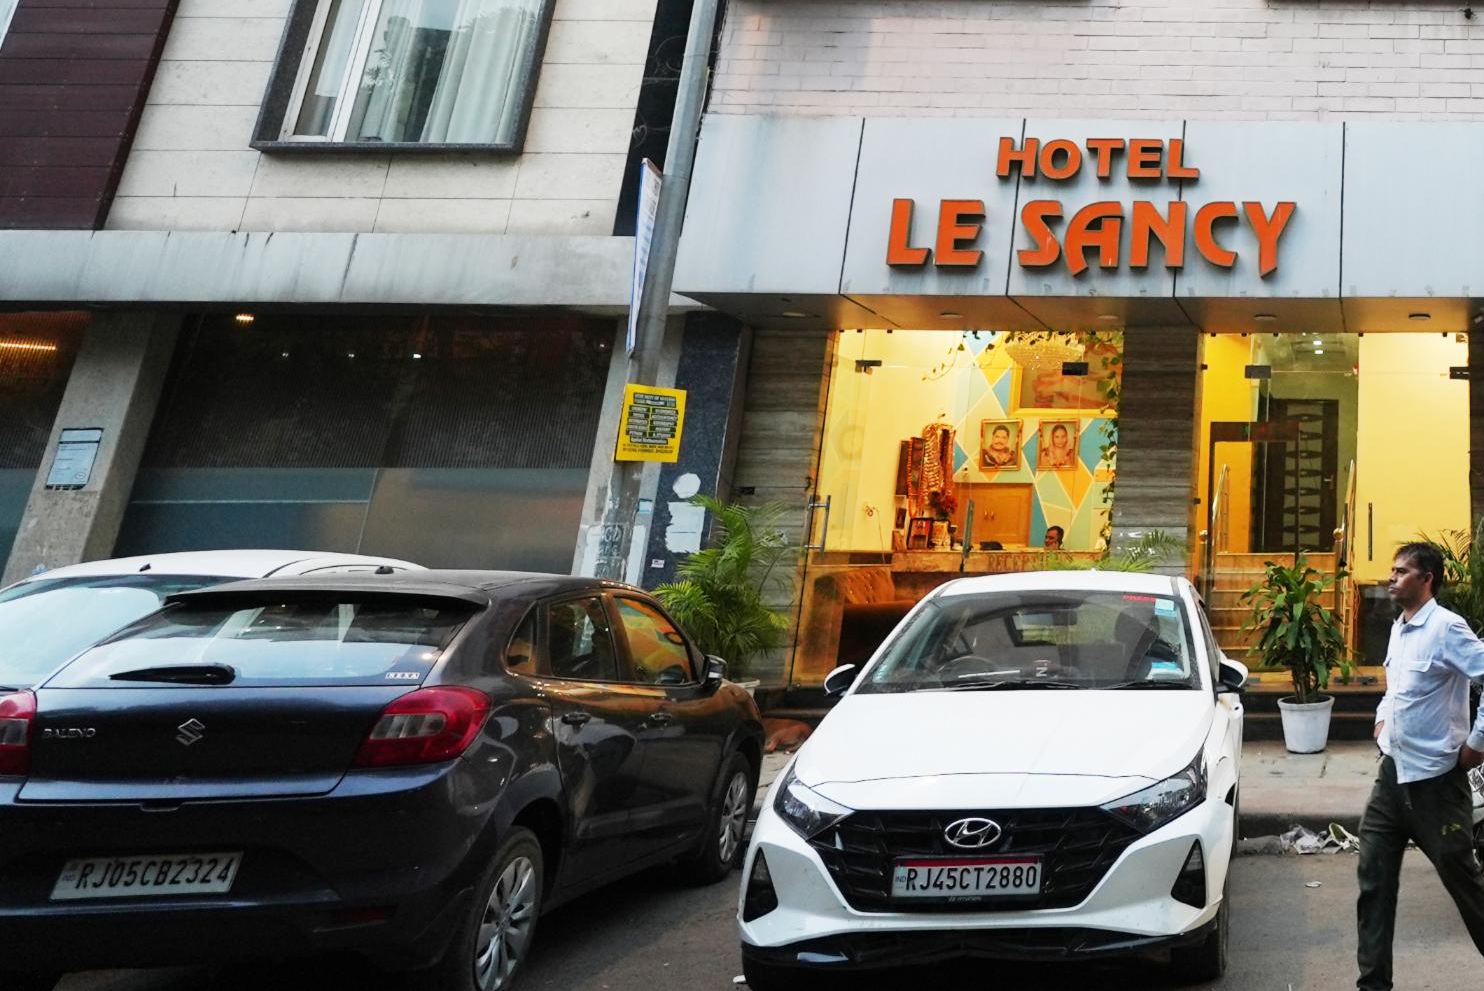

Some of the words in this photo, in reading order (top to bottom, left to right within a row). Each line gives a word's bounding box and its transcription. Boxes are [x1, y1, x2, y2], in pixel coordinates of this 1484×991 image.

[996, 137, 1200, 180] HOTEL
[886, 198, 986, 267] LE
[1017, 199, 1298, 278] SANCY
[43, 728, 96, 738] BALENO
[75, 857, 231, 889] RJ05CB2324
[906, 865, 1037, 891] RJ45CT2880
